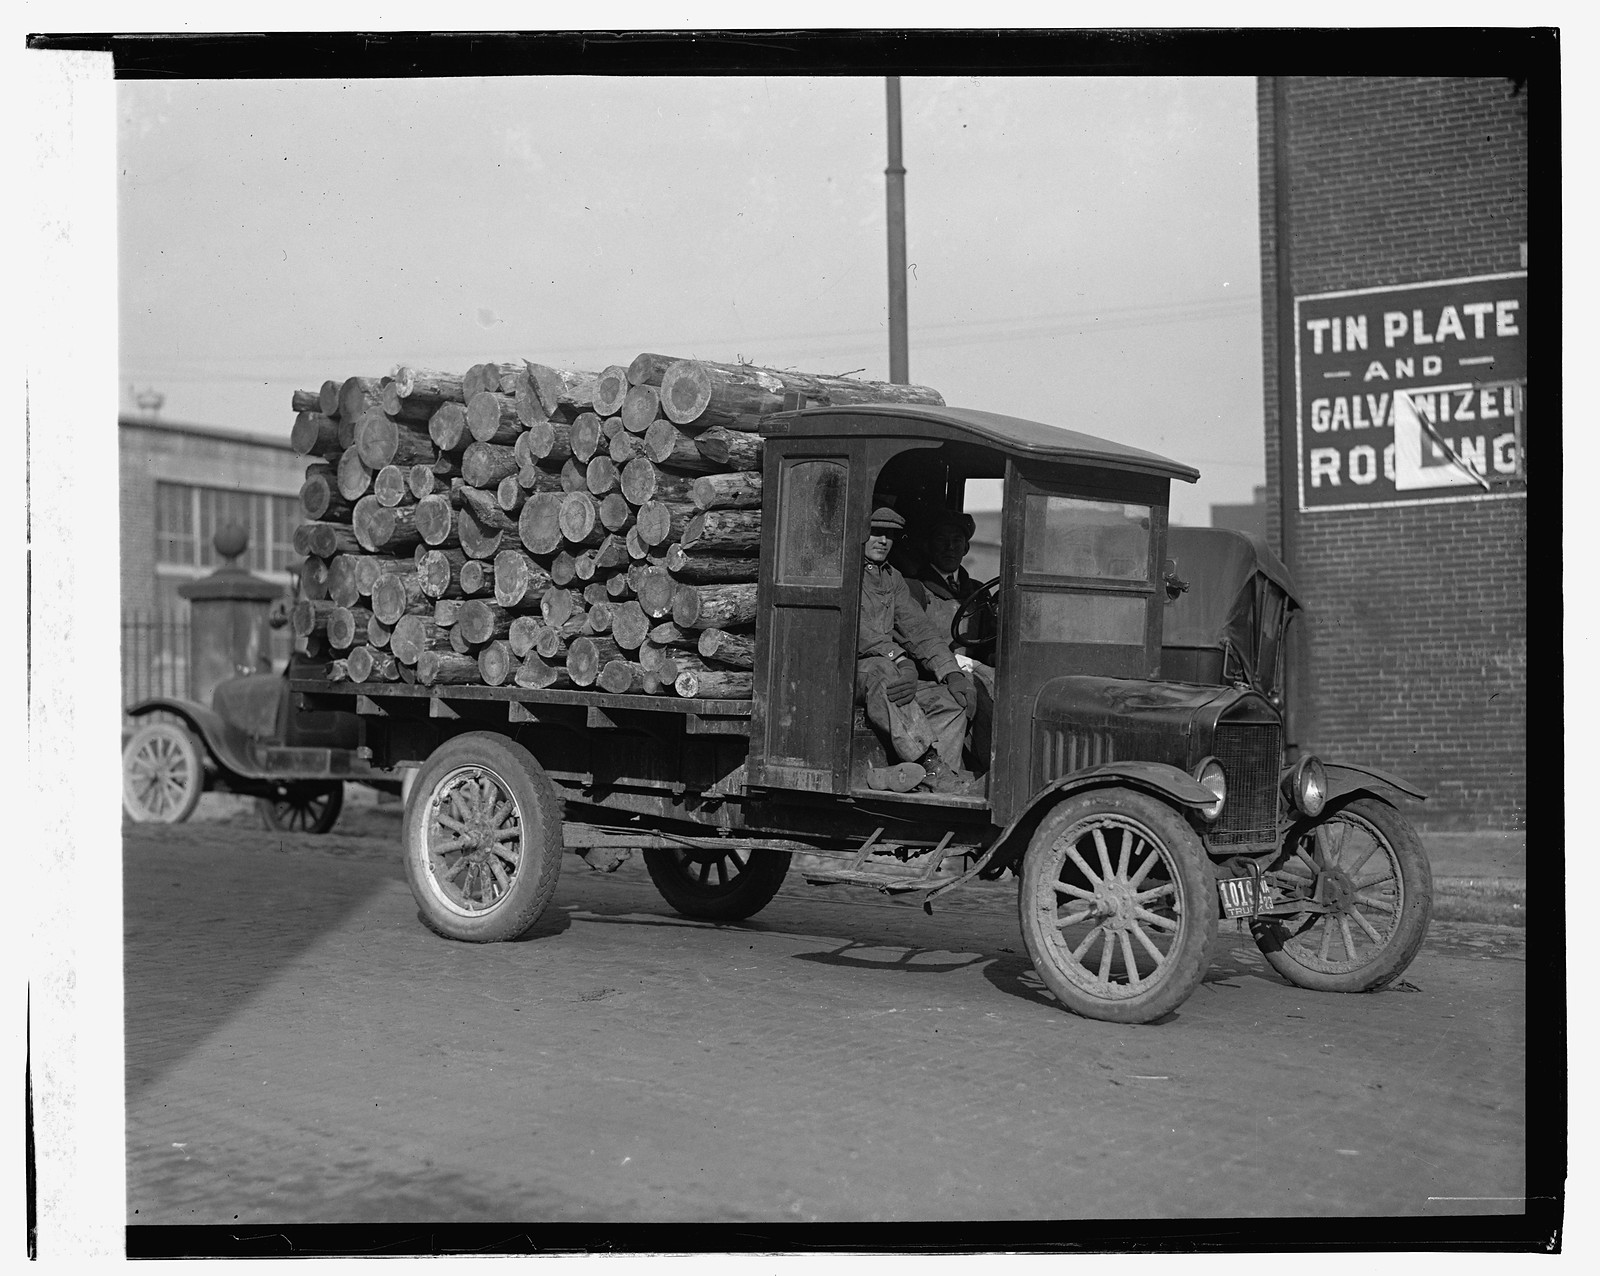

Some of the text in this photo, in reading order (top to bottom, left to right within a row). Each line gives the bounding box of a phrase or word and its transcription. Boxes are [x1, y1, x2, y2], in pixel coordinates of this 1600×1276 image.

[1306, 299, 1519, 354] TIN PLATE
[1363, 355, 1443, 382] AND
[1311, 385, 1523, 433] GALVNIZED
